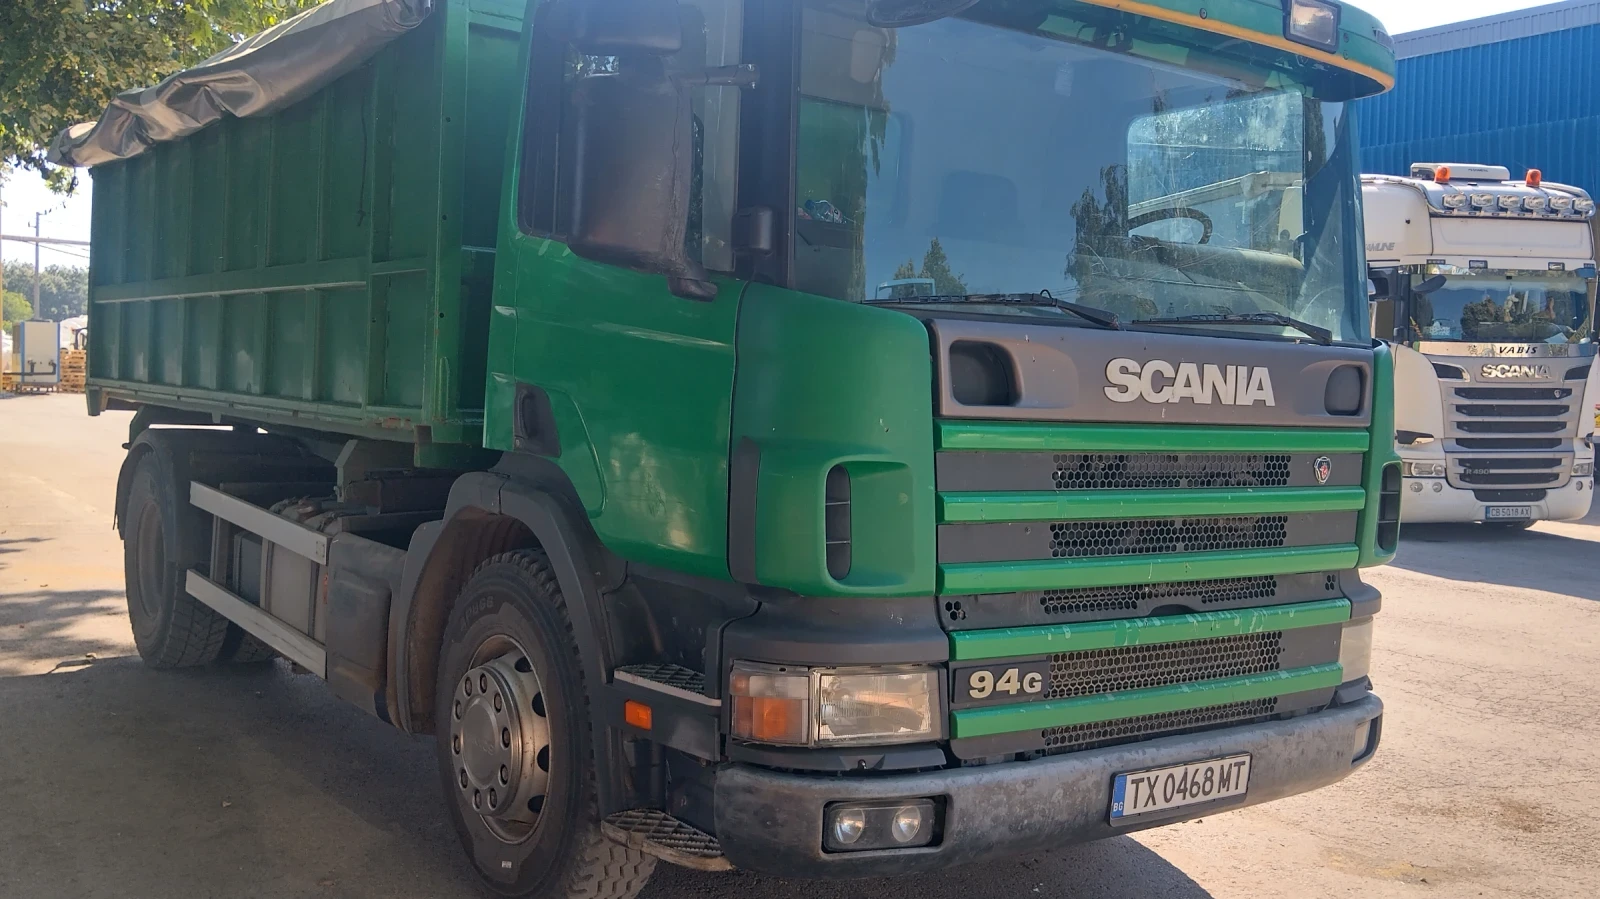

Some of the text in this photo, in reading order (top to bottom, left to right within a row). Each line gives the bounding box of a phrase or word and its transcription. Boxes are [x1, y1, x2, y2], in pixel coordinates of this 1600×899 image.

[1103, 357, 1276, 407] SCANIA
[1482, 364, 1552, 379] SCANIA
[969, 668, 1042, 699] 94G
[1131, 760, 1246, 809] TX 0468 MT
[1113, 801, 1124, 812] BG
